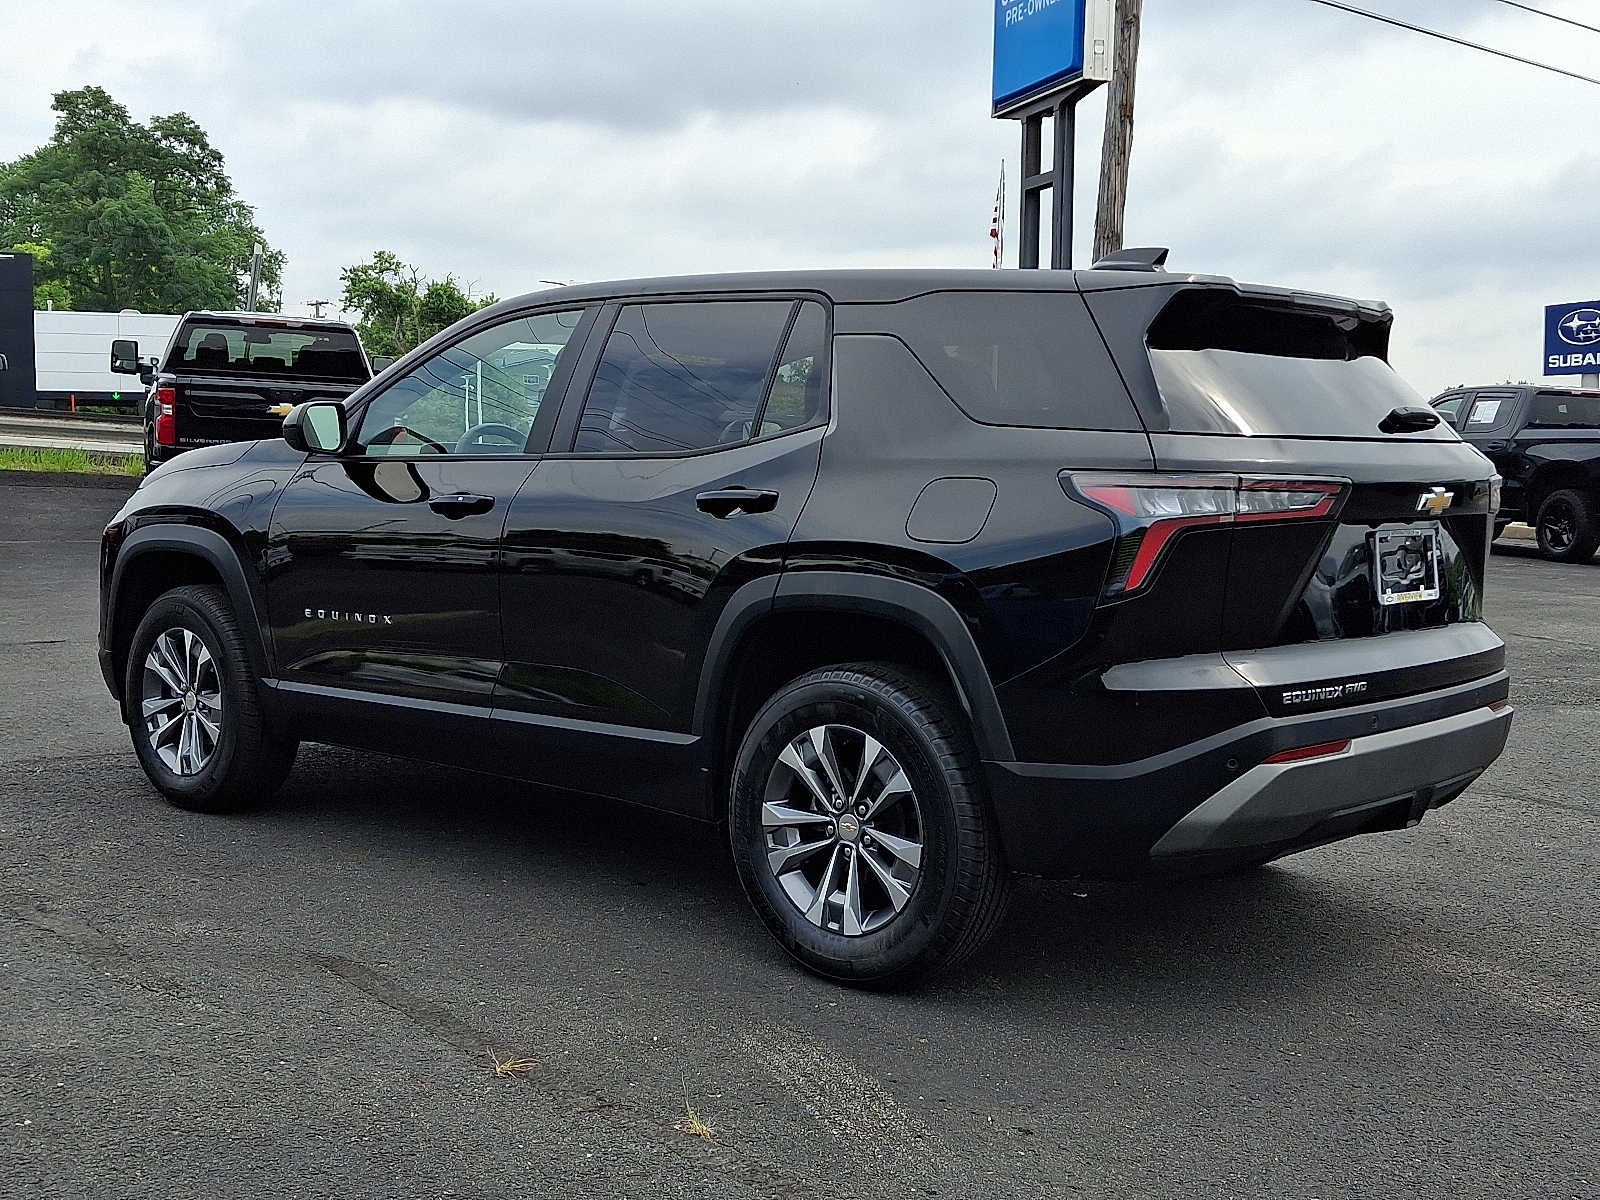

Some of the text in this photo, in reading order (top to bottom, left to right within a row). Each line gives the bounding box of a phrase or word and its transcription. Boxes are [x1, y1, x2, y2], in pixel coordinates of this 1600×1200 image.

[1004, 0, 1061, 29] PRE-OWN
[1548, 352, 1600, 368] SUBA
[304, 608, 392, 625] EQUINOX
[1282, 685, 1343, 705] EQUINOX
